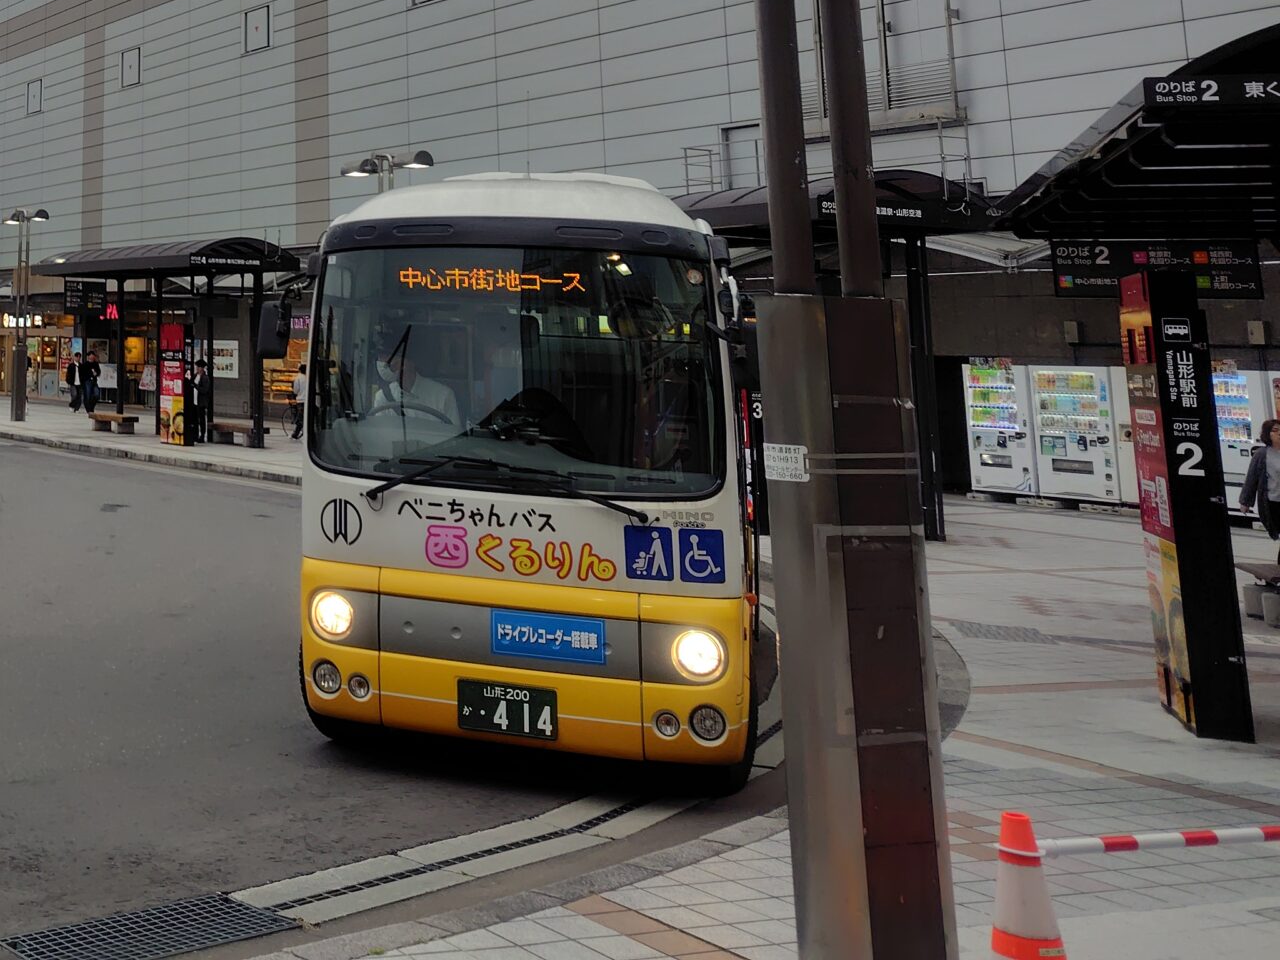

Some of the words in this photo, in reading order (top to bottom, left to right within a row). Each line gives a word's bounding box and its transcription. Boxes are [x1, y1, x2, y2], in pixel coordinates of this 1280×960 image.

[1155, 81, 1196, 93] のりば
[1200, 80, 1219, 101] 2
[1176, 95, 1198, 103] Stop
[1056, 246, 1090, 257] のりば
[1094, 246, 1110, 265] 2
[399, 267, 586, 293] 中心市街地コース
[1176, 350, 1198, 408] 山形駅前
[752, 402, 763, 419] 3
[1173, 422, 1199, 431] のりば
[1176, 442, 1205, 477] 2
[398, 499, 556, 532] ベニちゃんバス
[663, 511, 714, 521] HINO
[497, 623, 598, 650] ドライブレコーダー搭載車
